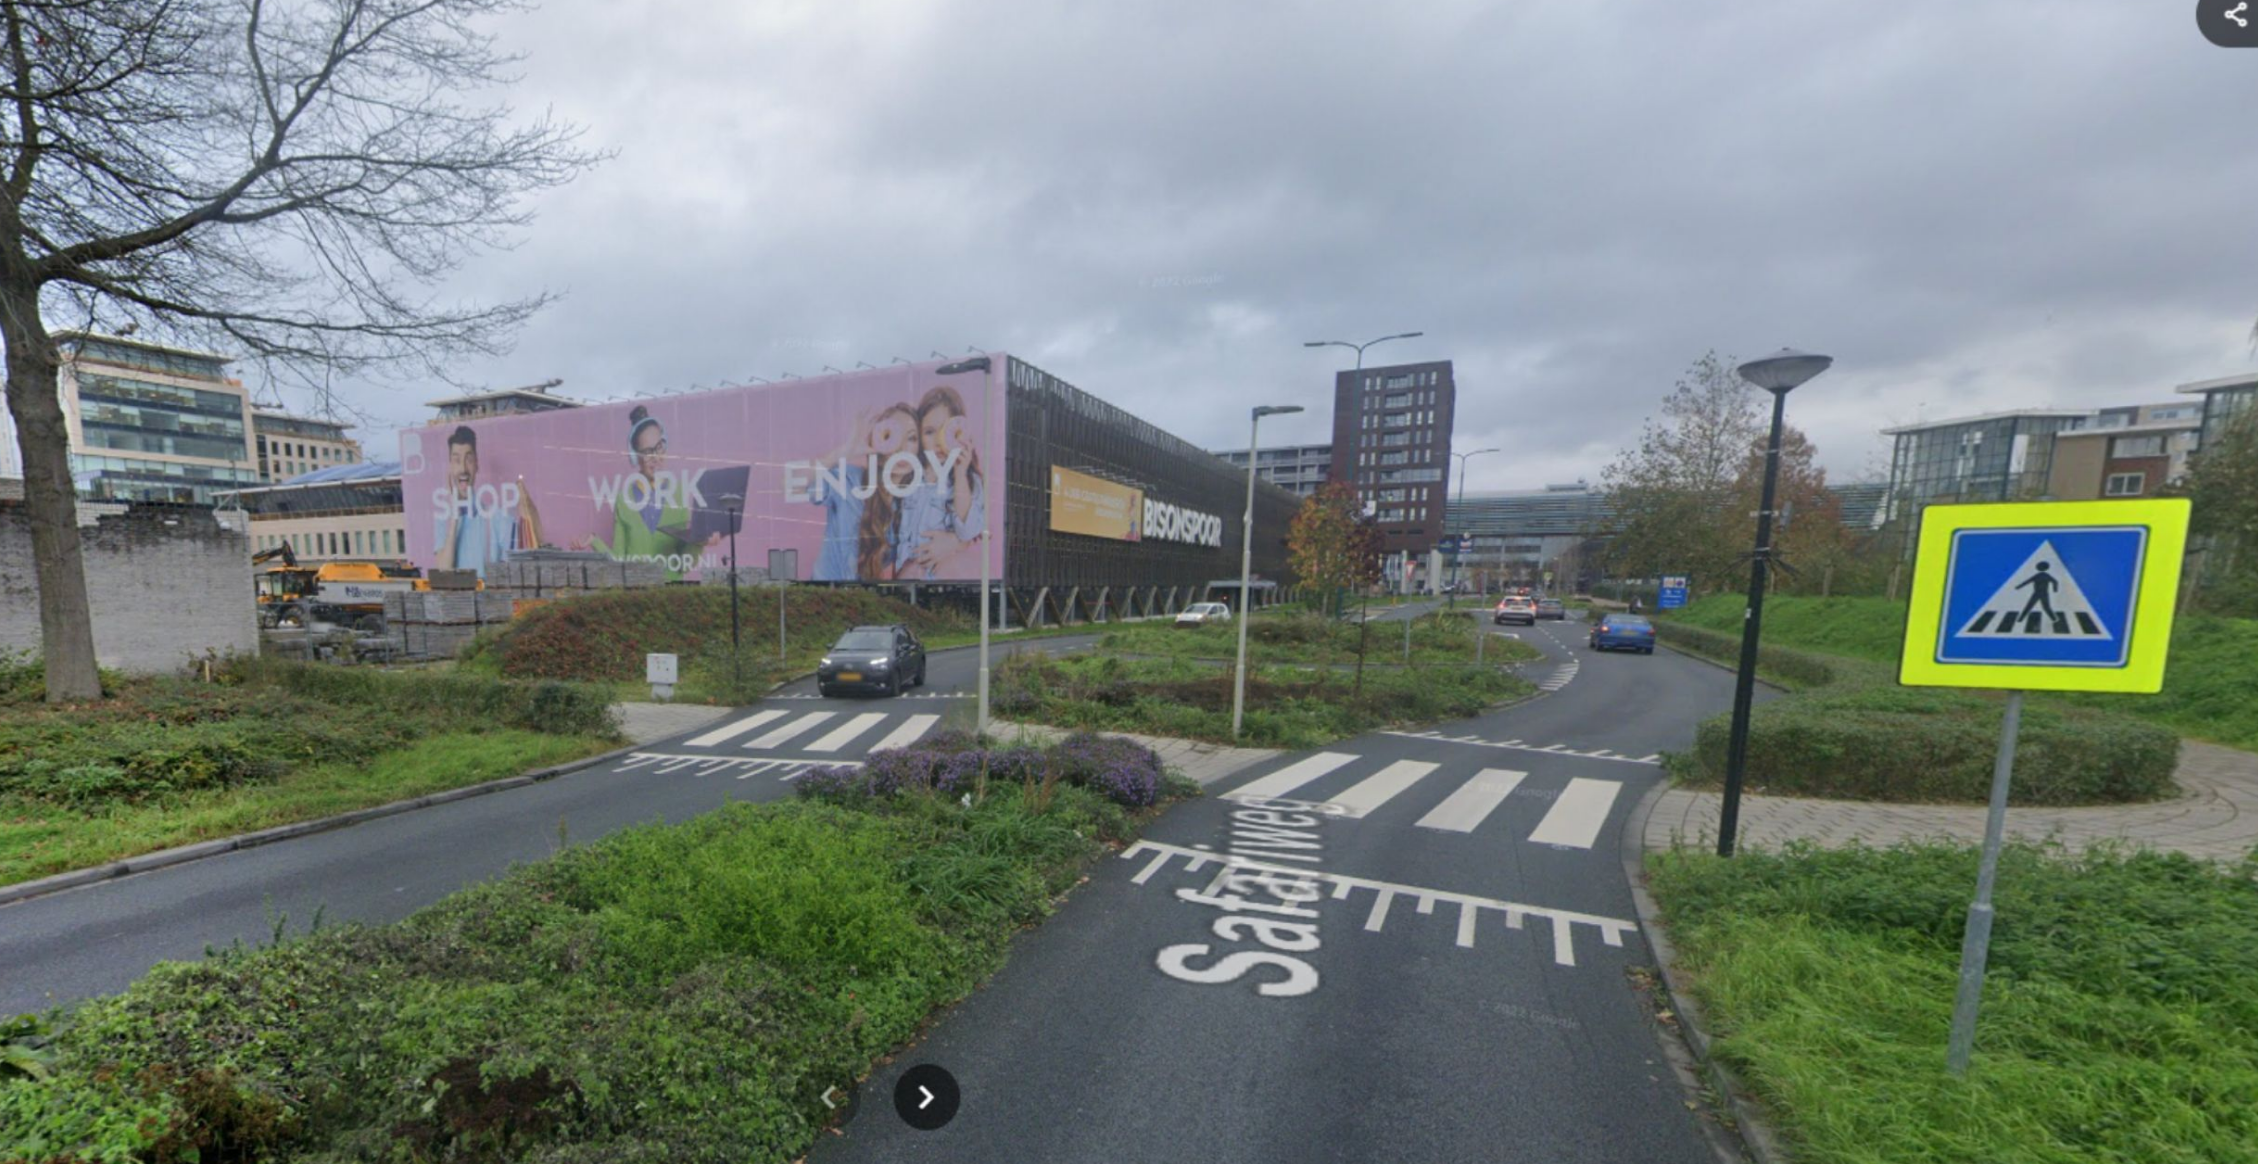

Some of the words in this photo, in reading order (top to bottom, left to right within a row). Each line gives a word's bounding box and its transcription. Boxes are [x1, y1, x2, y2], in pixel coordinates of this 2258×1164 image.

[588, 468, 708, 513] WORK
[785, 448, 962, 504] ENJOY
[432, 482, 520, 520] SHOP
[1143, 497, 1222, 547] BISONSPOOR
